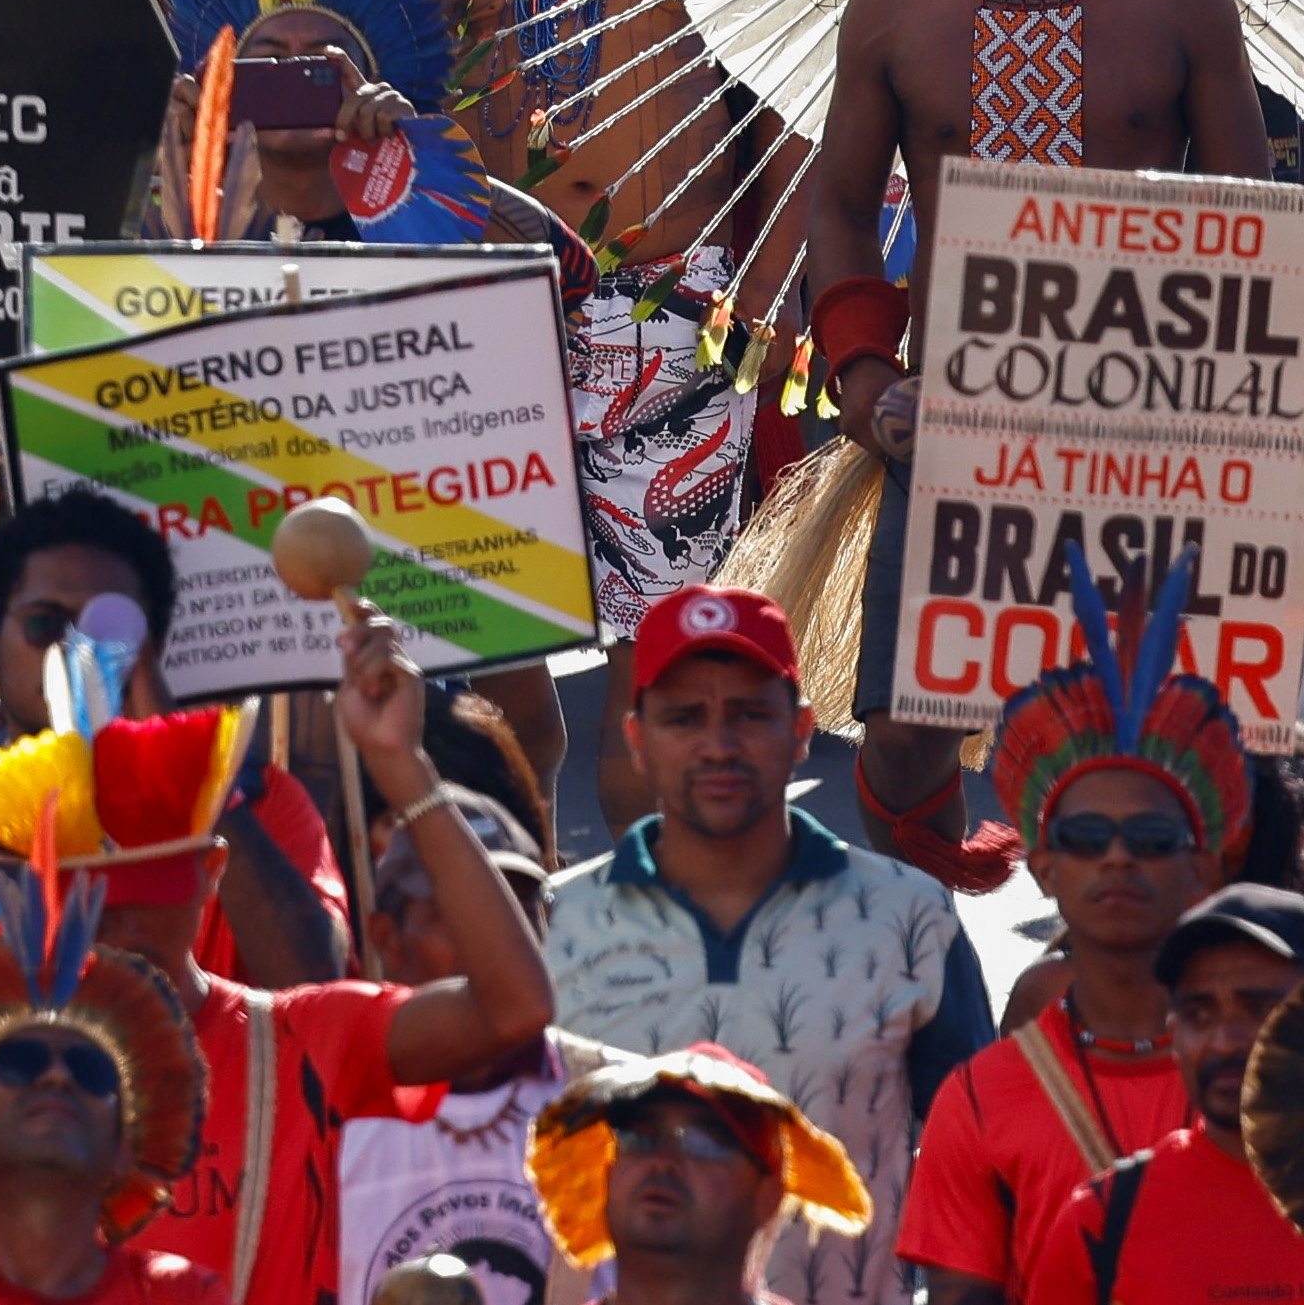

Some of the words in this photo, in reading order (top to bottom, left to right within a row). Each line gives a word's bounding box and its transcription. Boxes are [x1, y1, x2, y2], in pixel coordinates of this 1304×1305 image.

[1010, 198, 1183, 254] ANTES
[1196, 214, 1264, 259] DO
[960, 254, 1300, 356] BRASIL
[97, 348, 283, 410] GOVERNO
[296, 323, 473, 375] FEDERAL
[945, 337, 1302, 418] COLONIAL
[108, 395, 282, 452] MINISTÉRIO
[293, 395, 336, 420] DA
[345, 373, 471, 415] JUSTIÇA
[170, 441, 278, 472] Nacional
[288, 436, 330, 456] dos
[339, 422, 415, 452] Povos
[423, 403, 545, 438] Indígenas
[974, 436, 1044, 490] JÁ
[1057, 449, 1205, 500] TINHA
[1220, 460, 1252, 502] O
[929, 500, 1222, 616] BRASIL
[1231, 544, 1286, 599] DO
